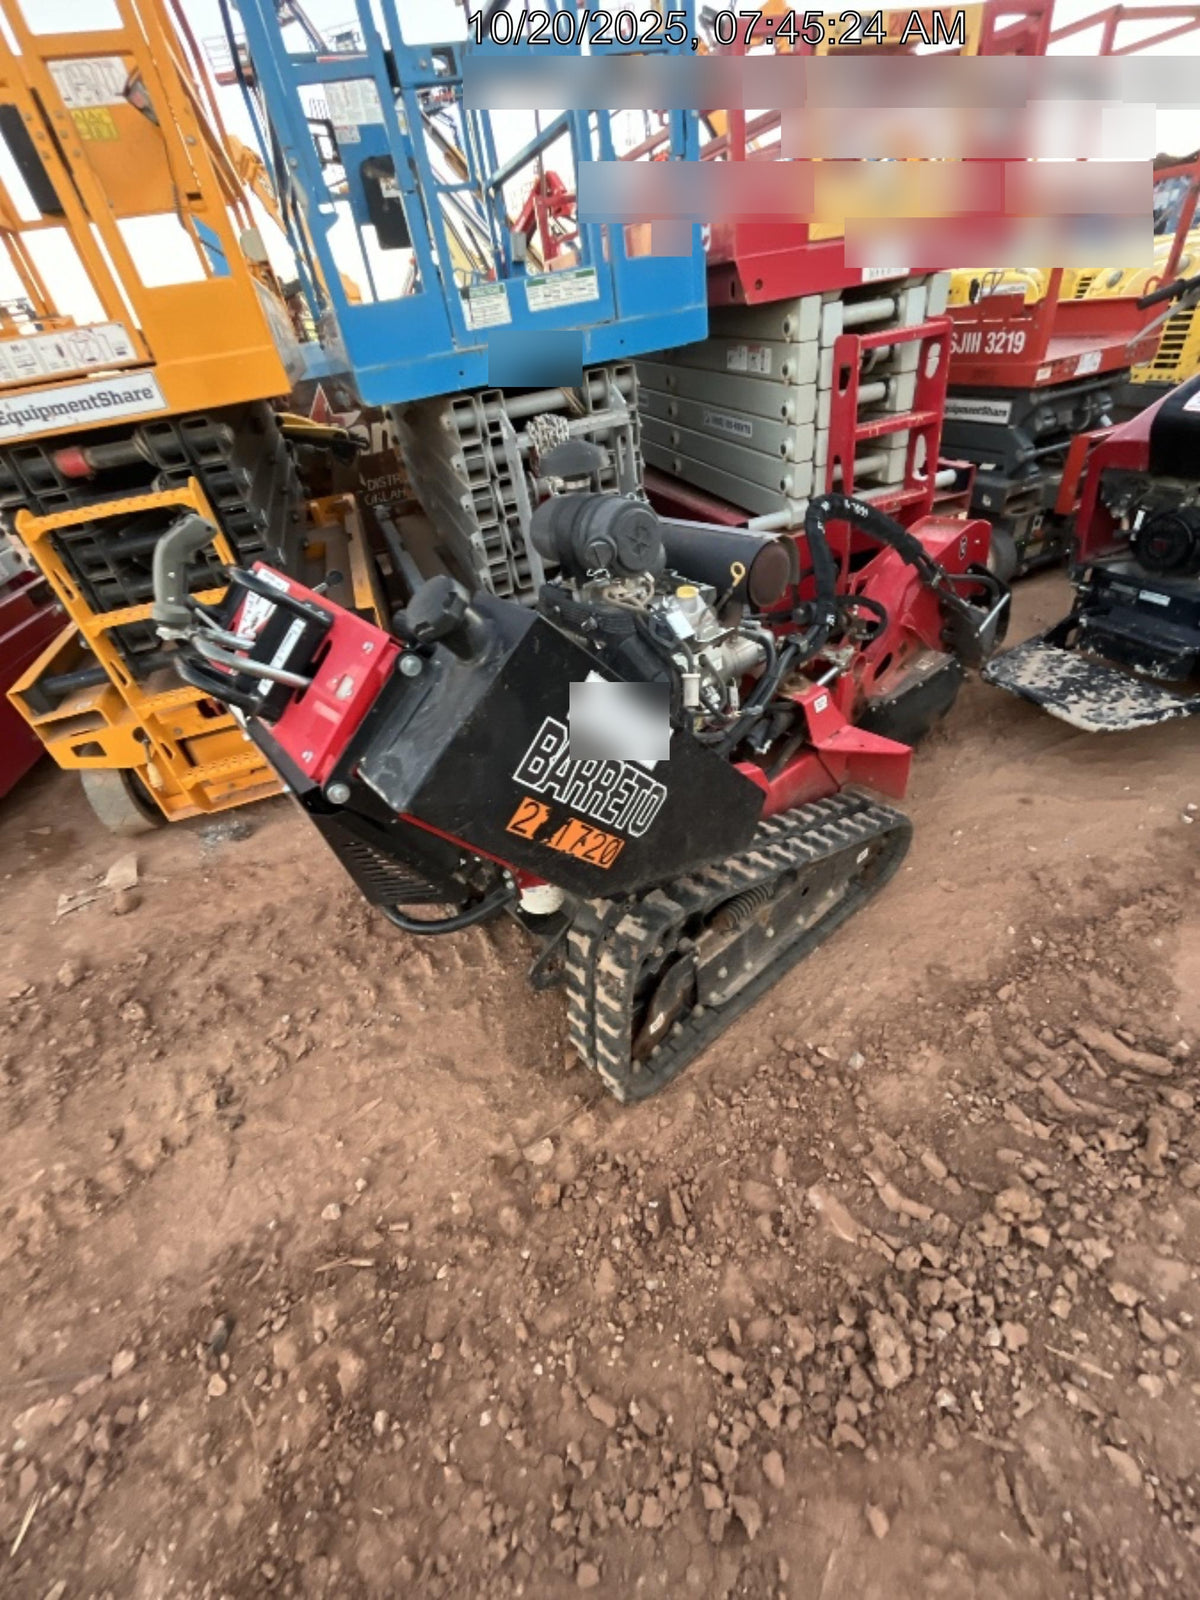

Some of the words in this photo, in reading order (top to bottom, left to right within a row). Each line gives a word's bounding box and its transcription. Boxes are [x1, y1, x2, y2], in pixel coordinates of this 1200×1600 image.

[984, 330, 1026, 355] 3219
[0, 386, 154, 427] EquipmentShare
[512, 716, 668, 838] BARRETO
[509, 800, 622, 866] 21720
